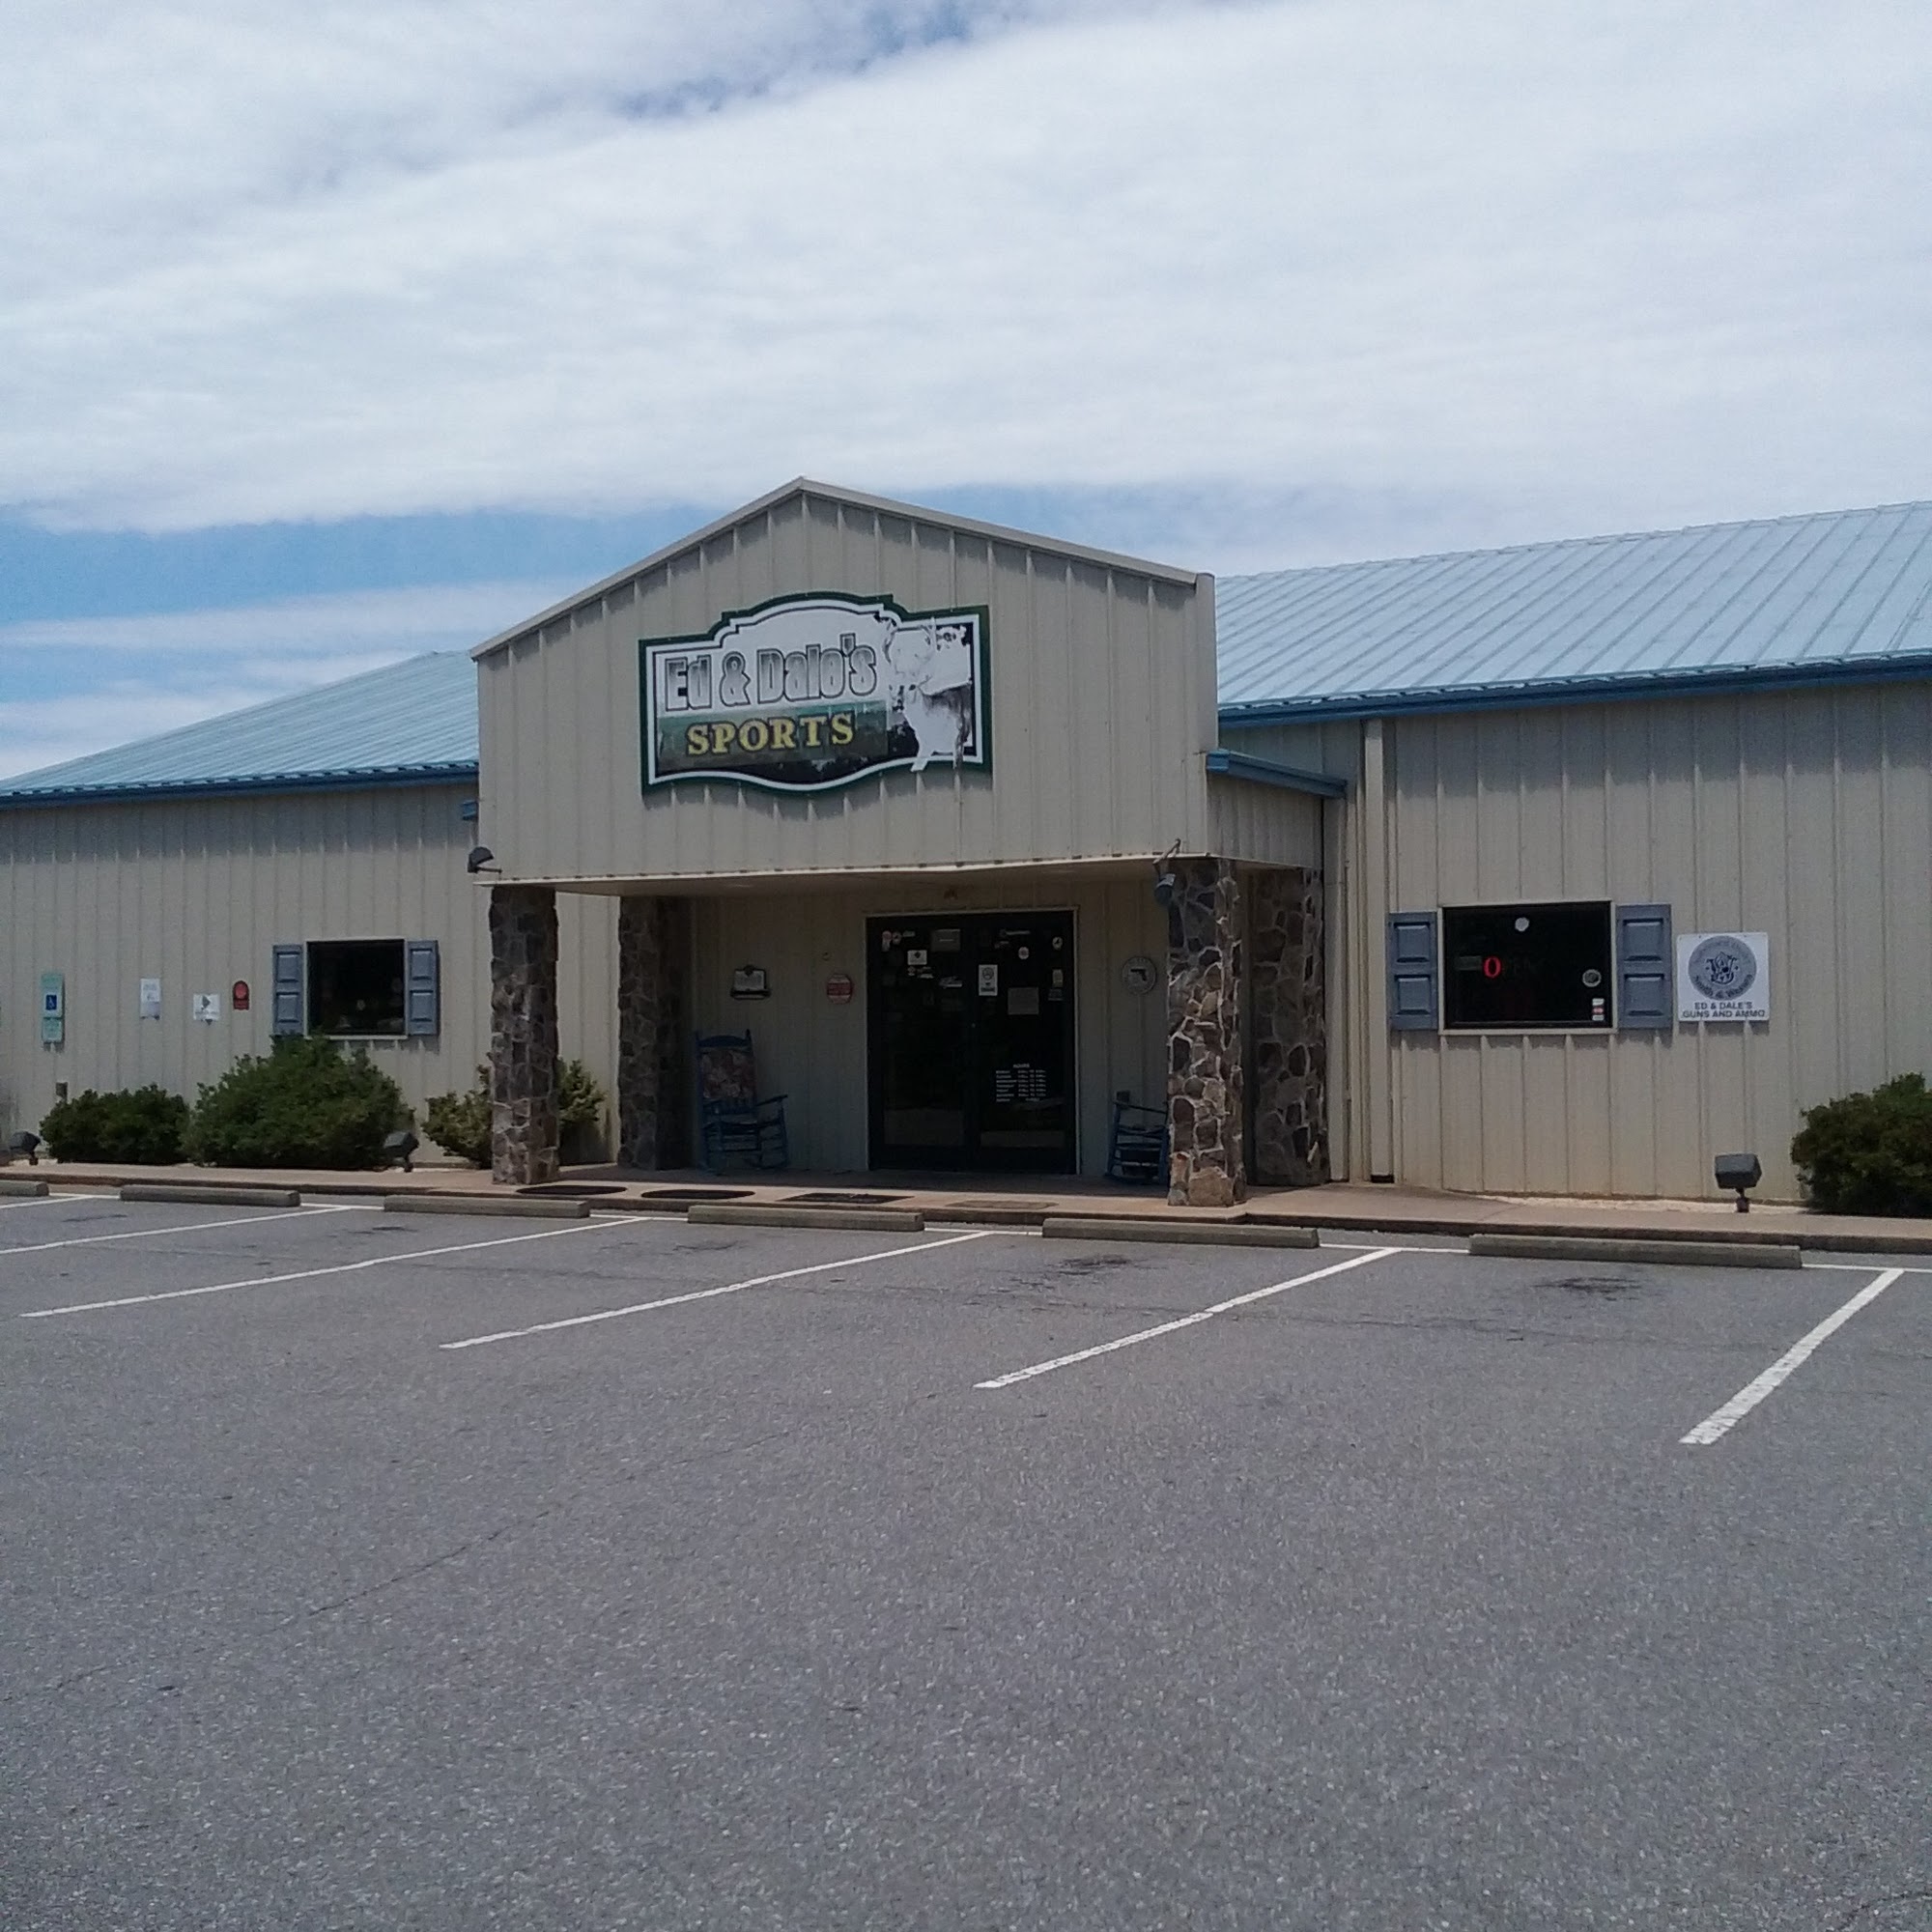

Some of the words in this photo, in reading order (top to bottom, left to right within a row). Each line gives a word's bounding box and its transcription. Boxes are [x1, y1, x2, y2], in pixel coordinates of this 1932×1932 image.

[666, 654, 712, 711] Ed
[720, 651, 751, 706] &
[686, 711, 856, 755] SPORTS
[1719, 1001, 1752, 1009] DALE'S
